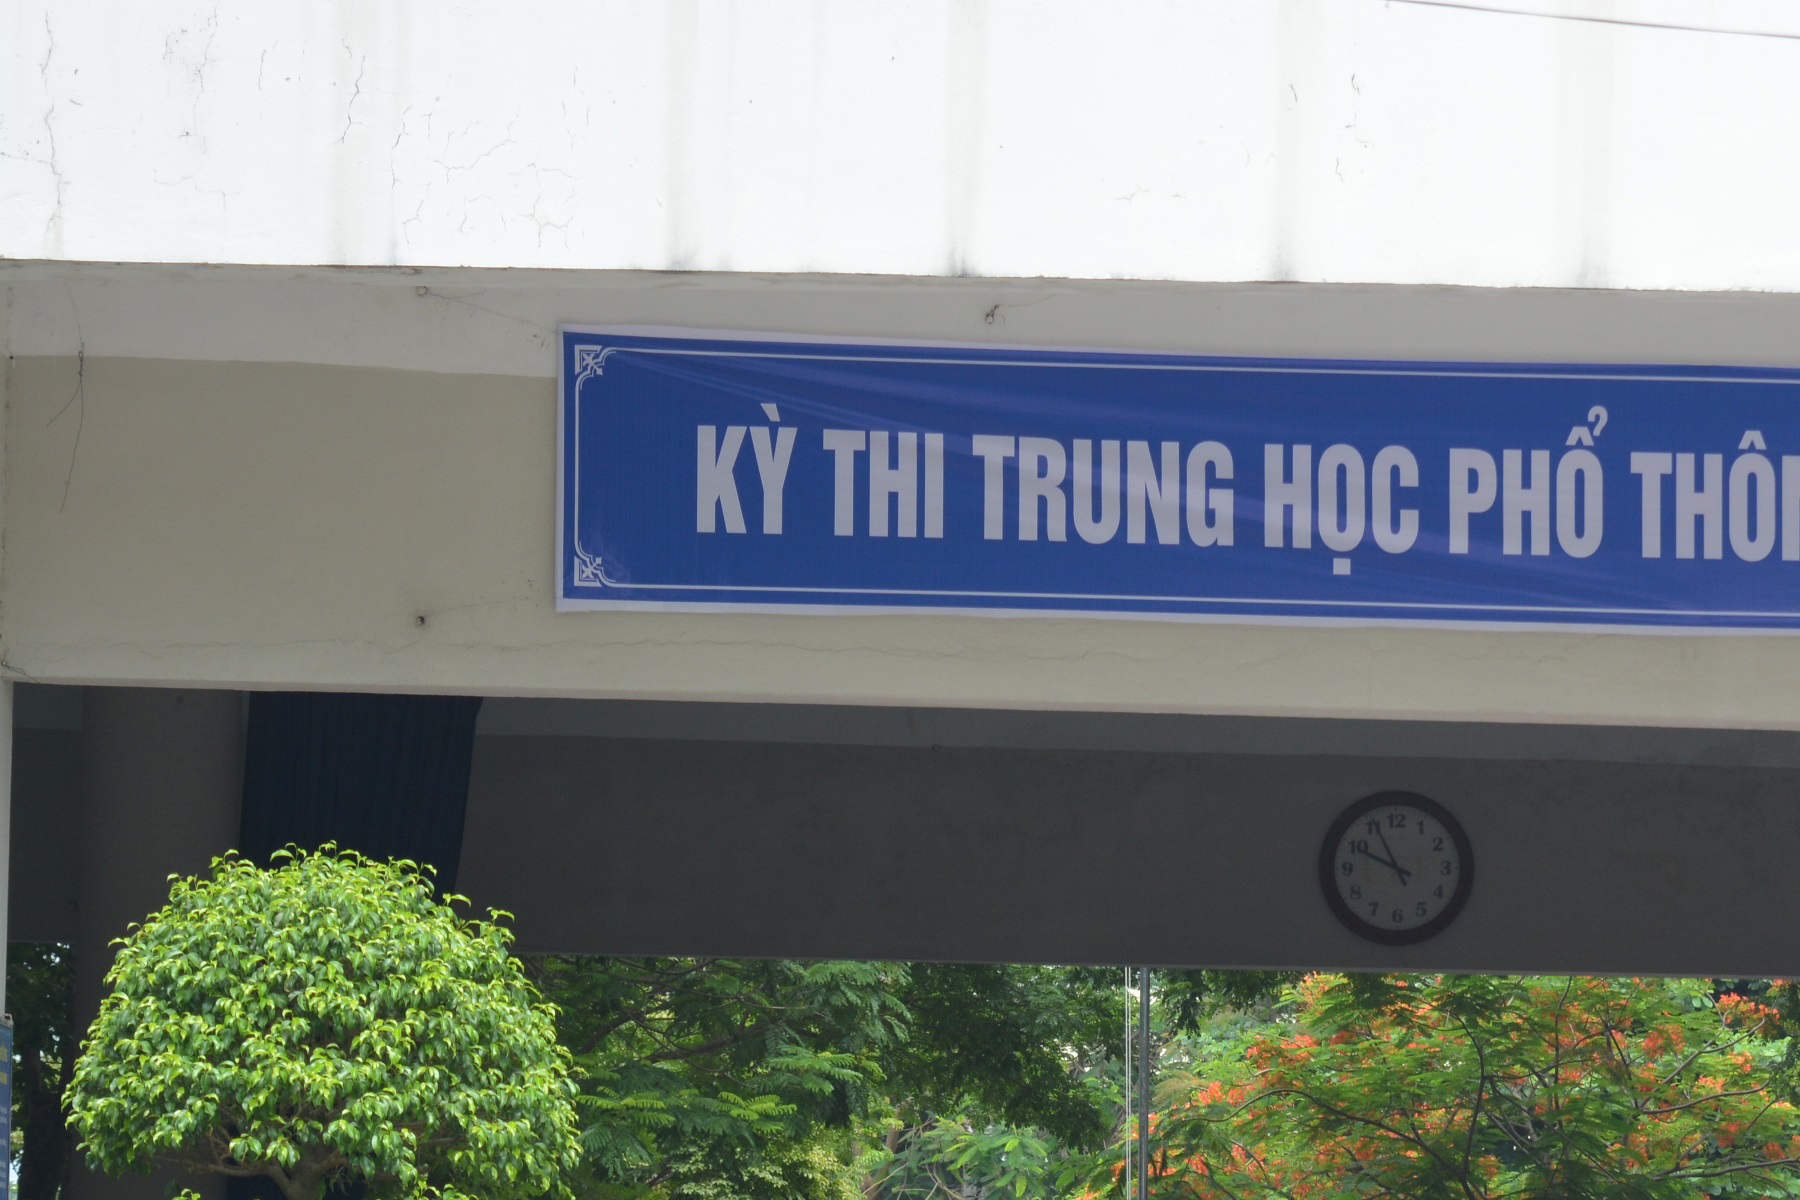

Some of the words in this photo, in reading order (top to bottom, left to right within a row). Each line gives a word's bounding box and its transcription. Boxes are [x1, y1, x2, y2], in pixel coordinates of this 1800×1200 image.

[696, 403, 798, 535] KỲ
[822, 428, 944, 539] THI
[972, 434, 1234, 547] TRUNG
[1264, 443, 1419, 576] HỌC
[1448, 405, 1608, 559] PHỔ
[1365, 820, 1381, 835] 11
[1386, 813, 1406, 828] 12
[1416, 820, 1424, 835] 1
[1348, 840, 1369, 854] 10
[1432, 837, 1444, 852] 2
[1342, 861, 1354, 876] 9
[1440, 860, 1452, 875] 3
[1349, 885, 1362, 900] 8
[1433, 884, 1444, 899] 4
[1368, 902, 1379, 917] 7
[1391, 908, 1403, 923] 6
[1415, 902, 1427, 917] 5
